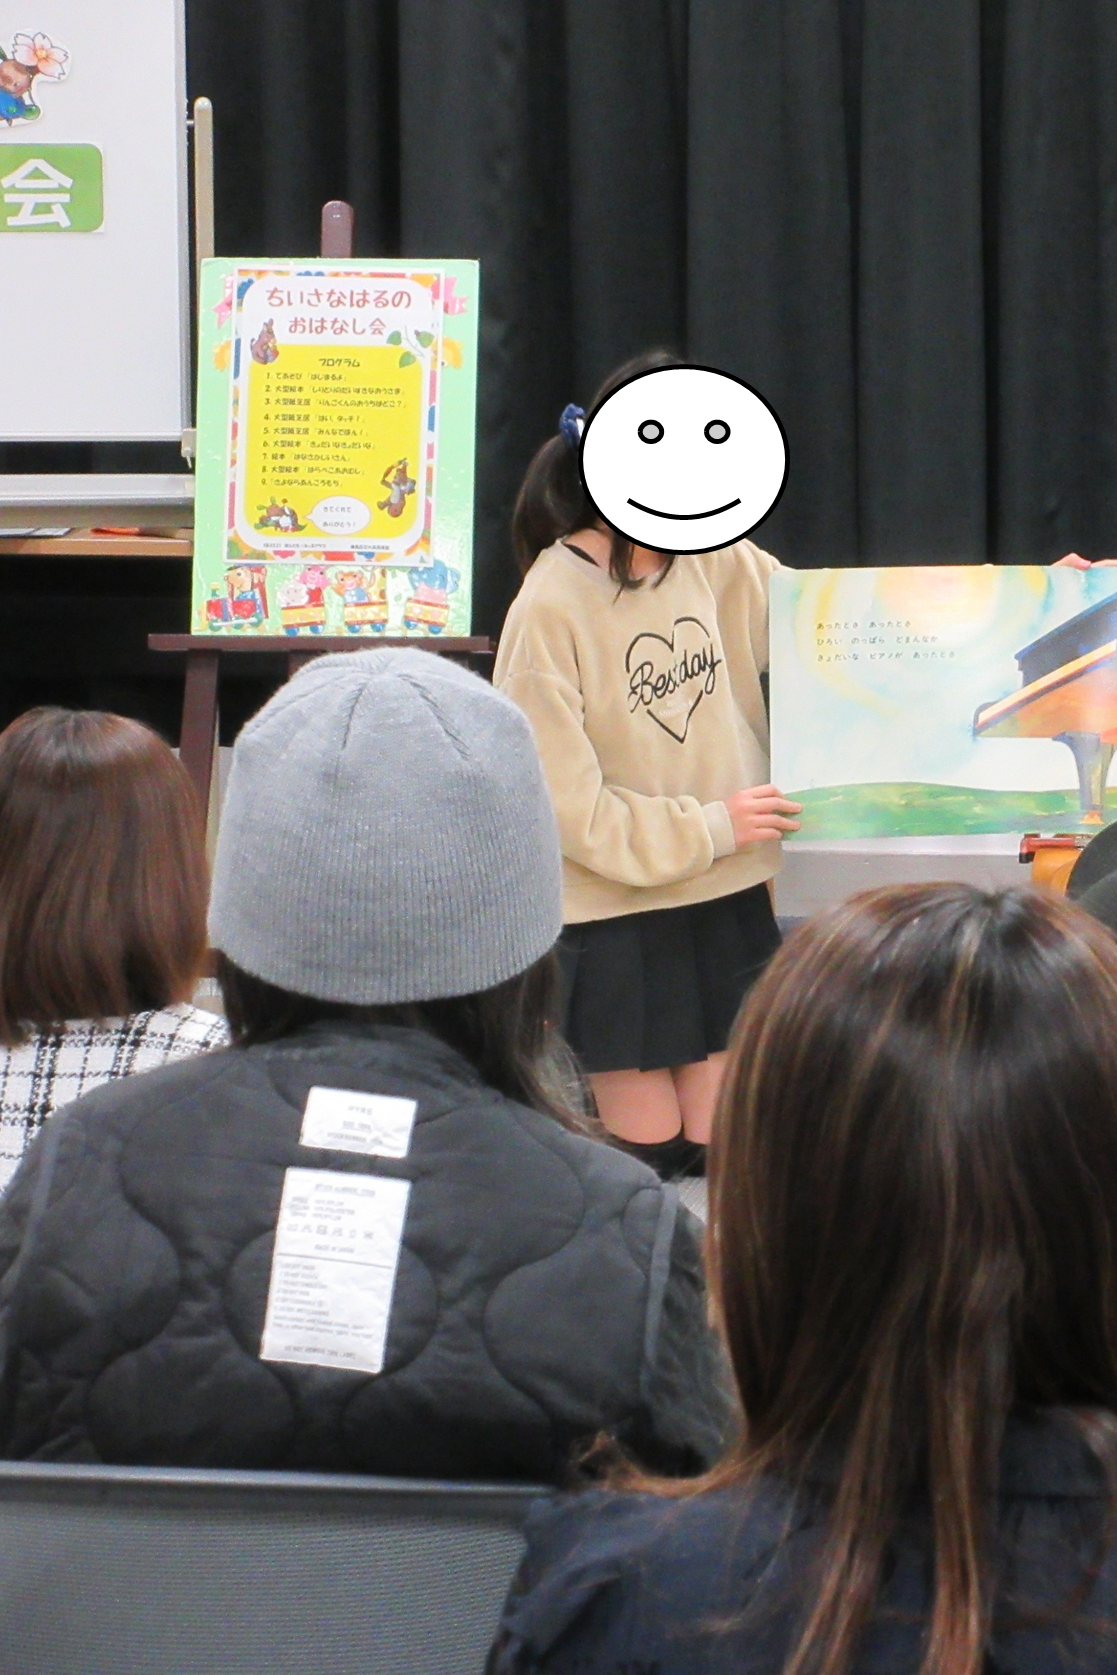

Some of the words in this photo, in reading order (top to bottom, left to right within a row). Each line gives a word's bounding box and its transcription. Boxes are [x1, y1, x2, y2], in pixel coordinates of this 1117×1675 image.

[0, 158, 74, 229] 会
[266, 287, 412, 309] ちいさなはるの
[288, 316, 387, 336] おはなし会
[318, 358, 361, 368] プログラム
[275, 372, 302, 380] てあそび
[274, 385, 304, 393] 大型絵本
[274, 398, 311, 406] 大型紙芝居
[274, 413, 310, 422] 大型紙芝居
[273, 427, 309, 435] 大型紙芝居
[272, 440, 302, 448] 大型絵本
[271, 466, 299, 474] 大型絵本
[816, 622, 859, 630] あったとき
[868, 620, 912, 629] あったとき
[816, 638, 842, 646] ひろい
[895, 635, 939, 644] どまんなか
[817, 653, 860, 661] きょだいな
[869, 651, 903, 660] ピアノが
[912, 650, 956, 659] あったとき
